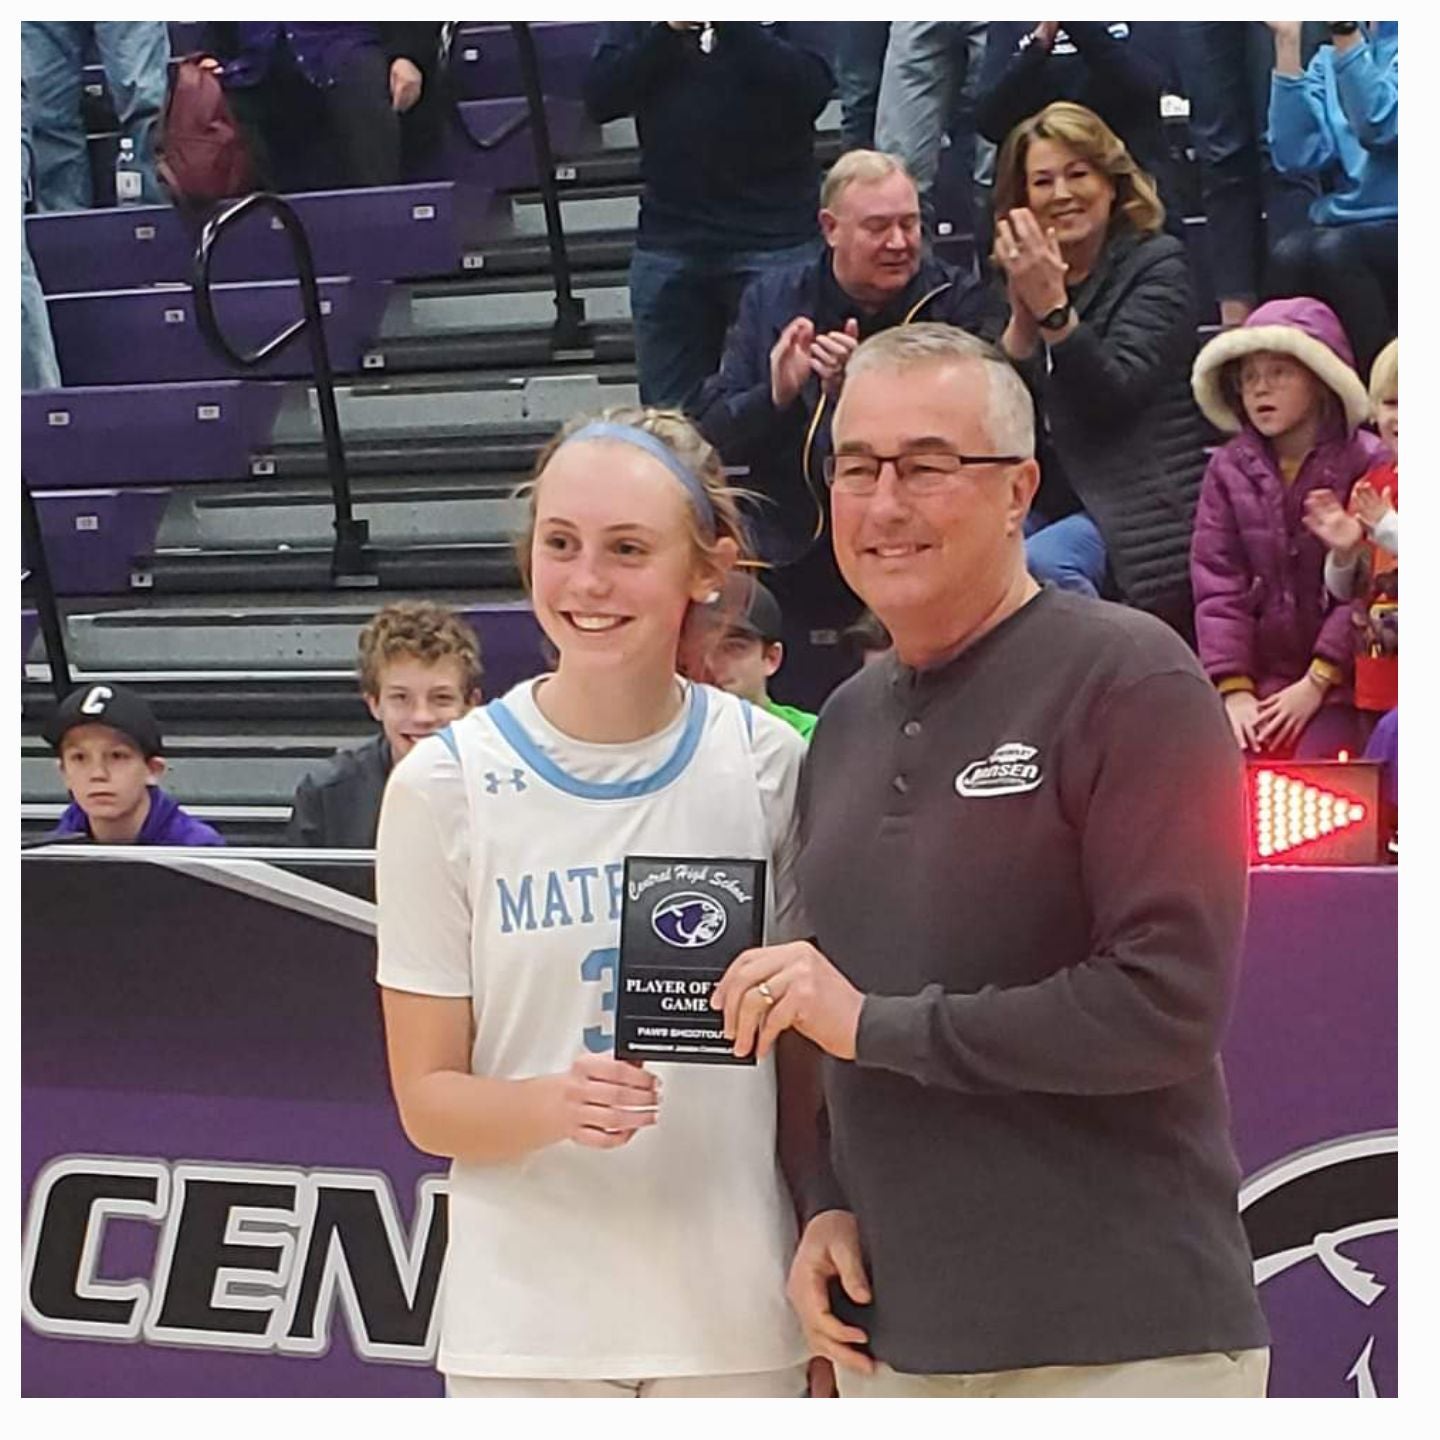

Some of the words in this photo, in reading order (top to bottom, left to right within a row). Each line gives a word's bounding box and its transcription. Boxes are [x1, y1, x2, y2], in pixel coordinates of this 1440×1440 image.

[80, 686, 113, 715] C
[628, 866, 672, 901] Central
[673, 864, 708, 883] High
[709, 872, 754, 903] School
[626, 978, 686, 995] PLAYER
[689, 980, 711, 995] OF
[661, 997, 709, 1012] GAME
